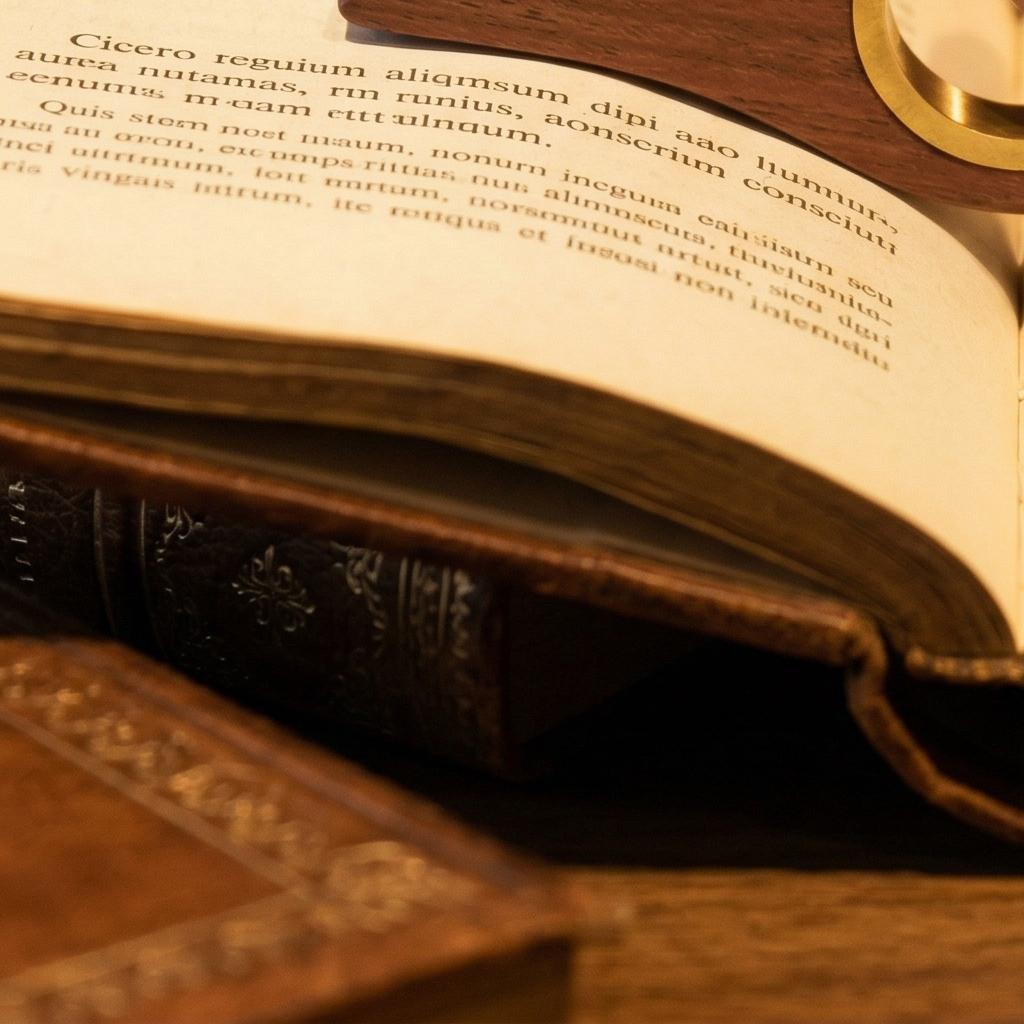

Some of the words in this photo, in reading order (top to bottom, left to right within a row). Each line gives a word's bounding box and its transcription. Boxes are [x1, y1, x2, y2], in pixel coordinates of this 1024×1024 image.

[70, 33, 196, 60] Cicero
[591, 102, 659, 131] dipi
[138, 65, 307, 96] nutamas,
[39, 100, 115, 120] Quis
